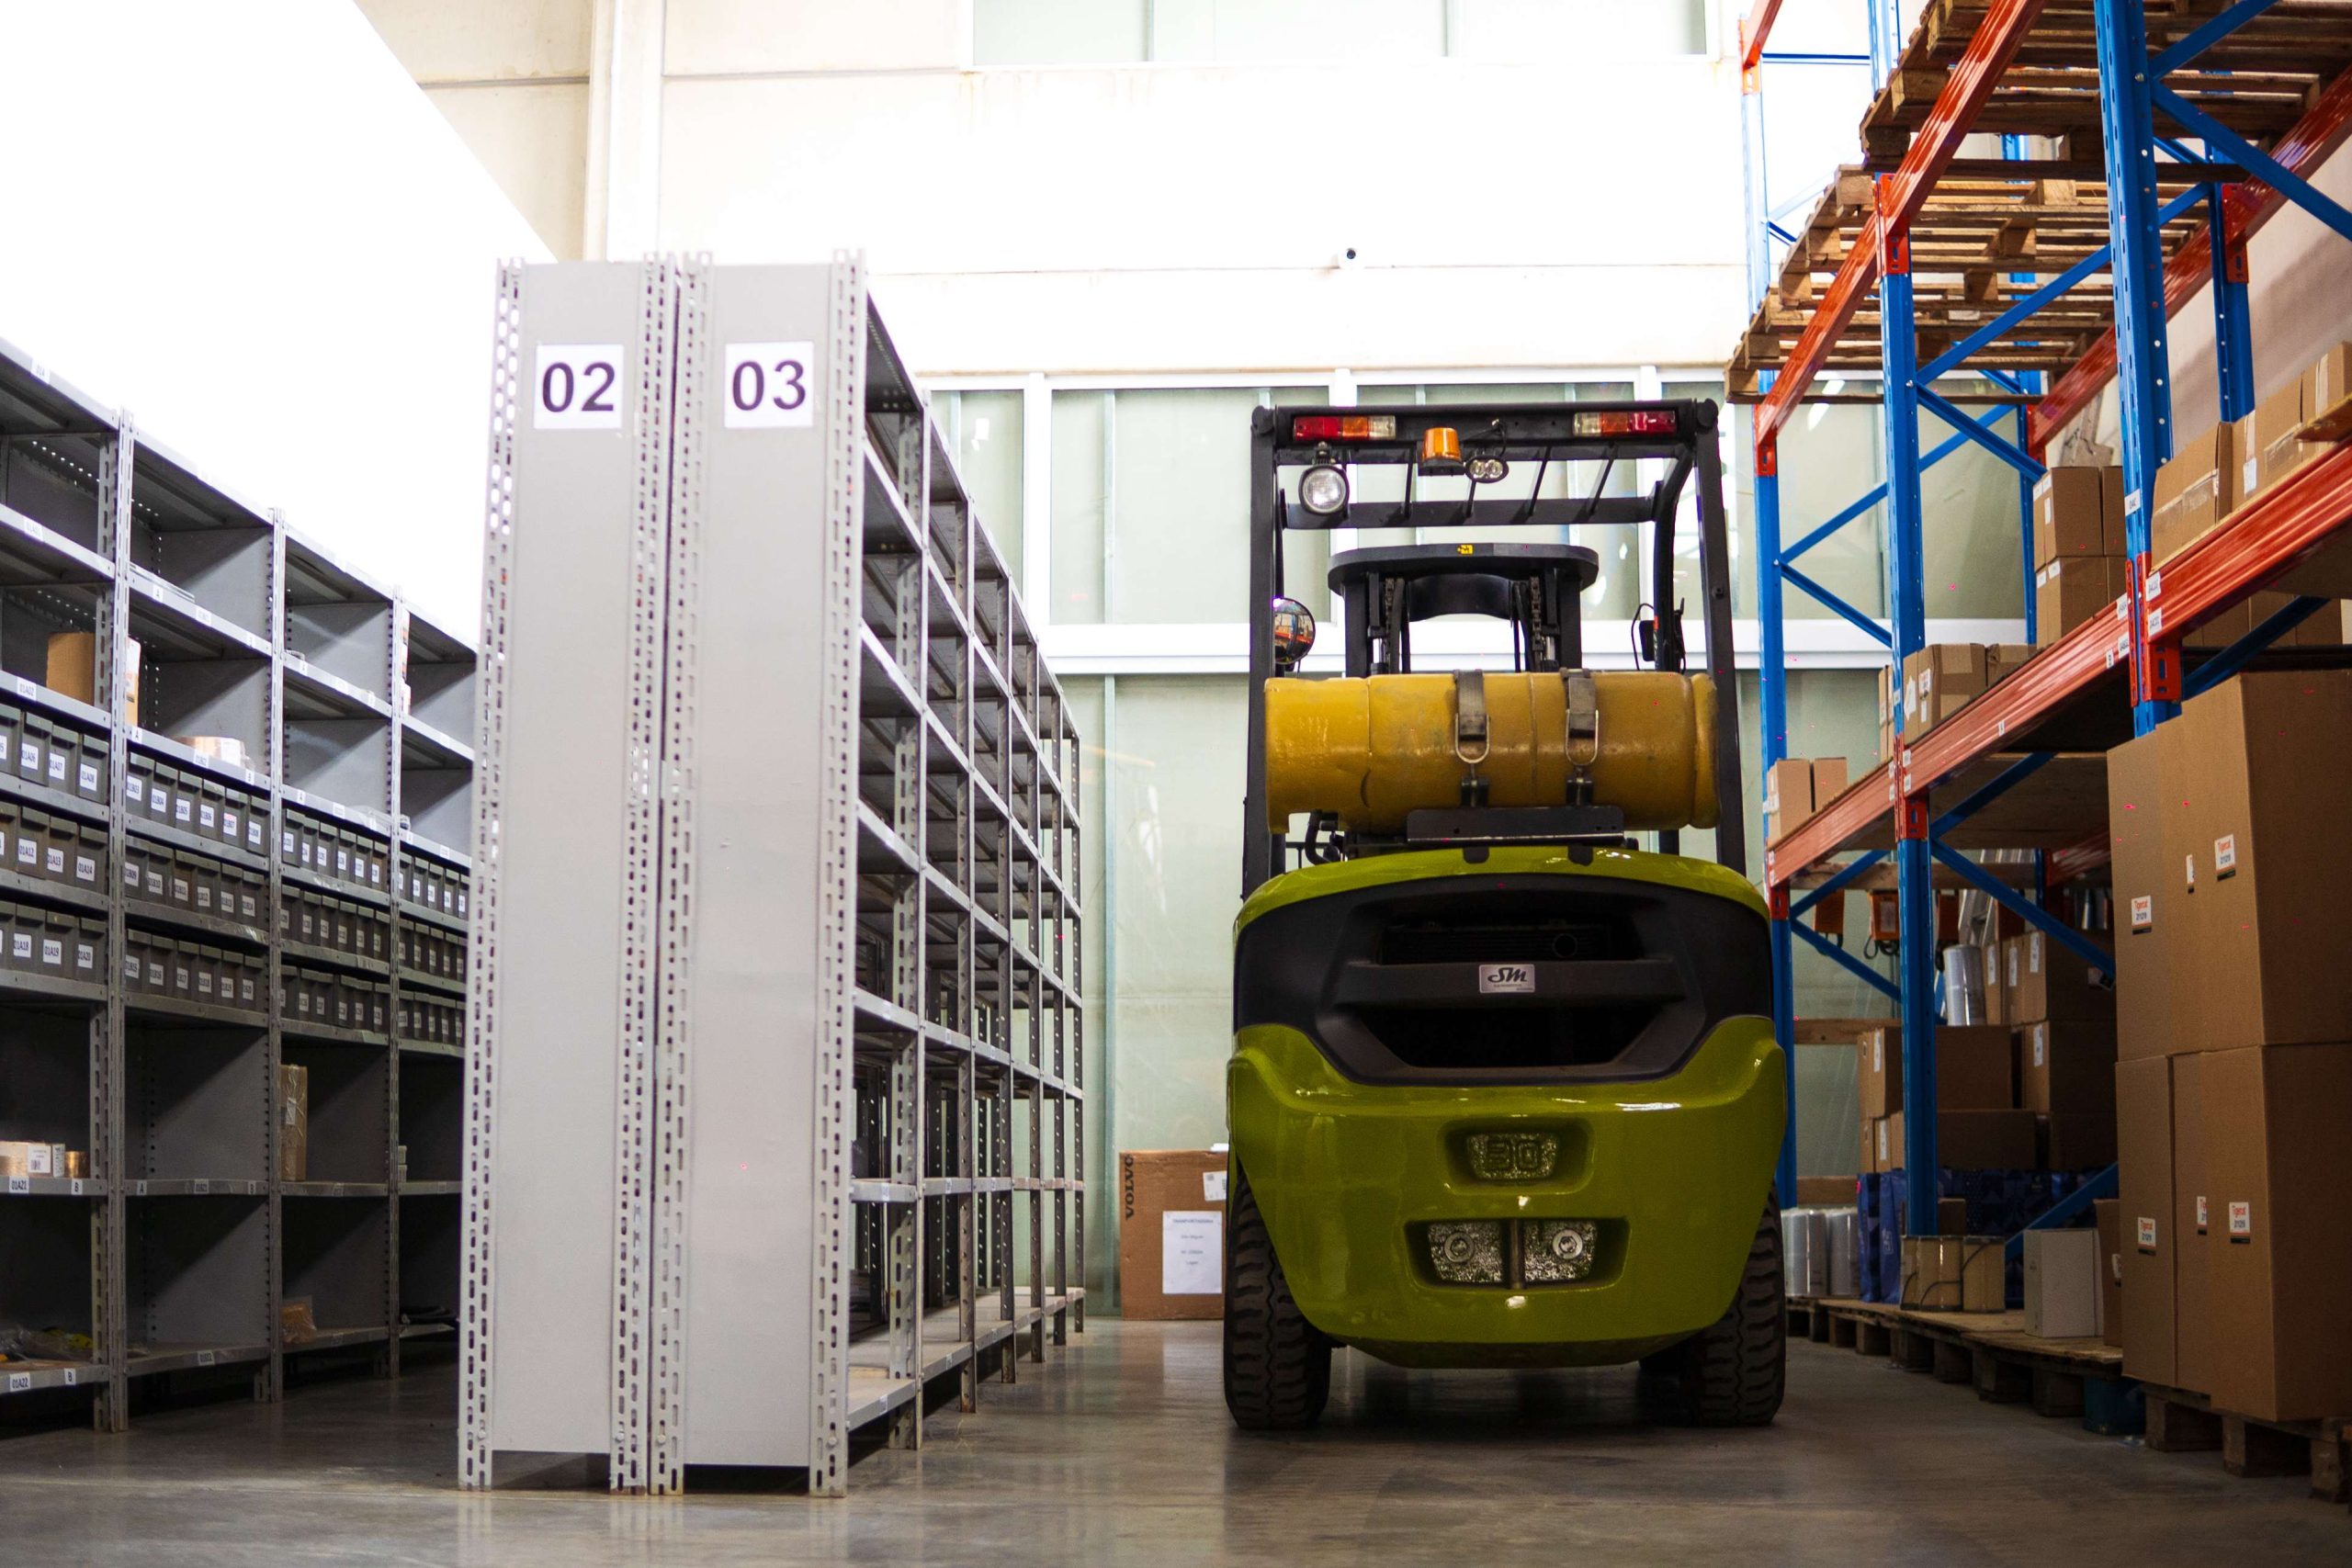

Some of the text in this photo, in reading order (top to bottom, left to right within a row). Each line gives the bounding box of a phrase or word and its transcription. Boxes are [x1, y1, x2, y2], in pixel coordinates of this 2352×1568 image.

[542, 362, 616, 412] 02
[732, 360, 807, 412] 03
[14, 940, 29, 953] 01A18
[44, 945, 60, 957] 01A19
[1487, 967, 1528, 983] SM
[11, 1179, 28, 1191] 01A21
[74, 1181, 79, 1192] B
[1124, 1154, 1135, 1221] VOLVO
[12, 1376, 29, 1389] 01A22
[67, 1371, 73, 1382] B
